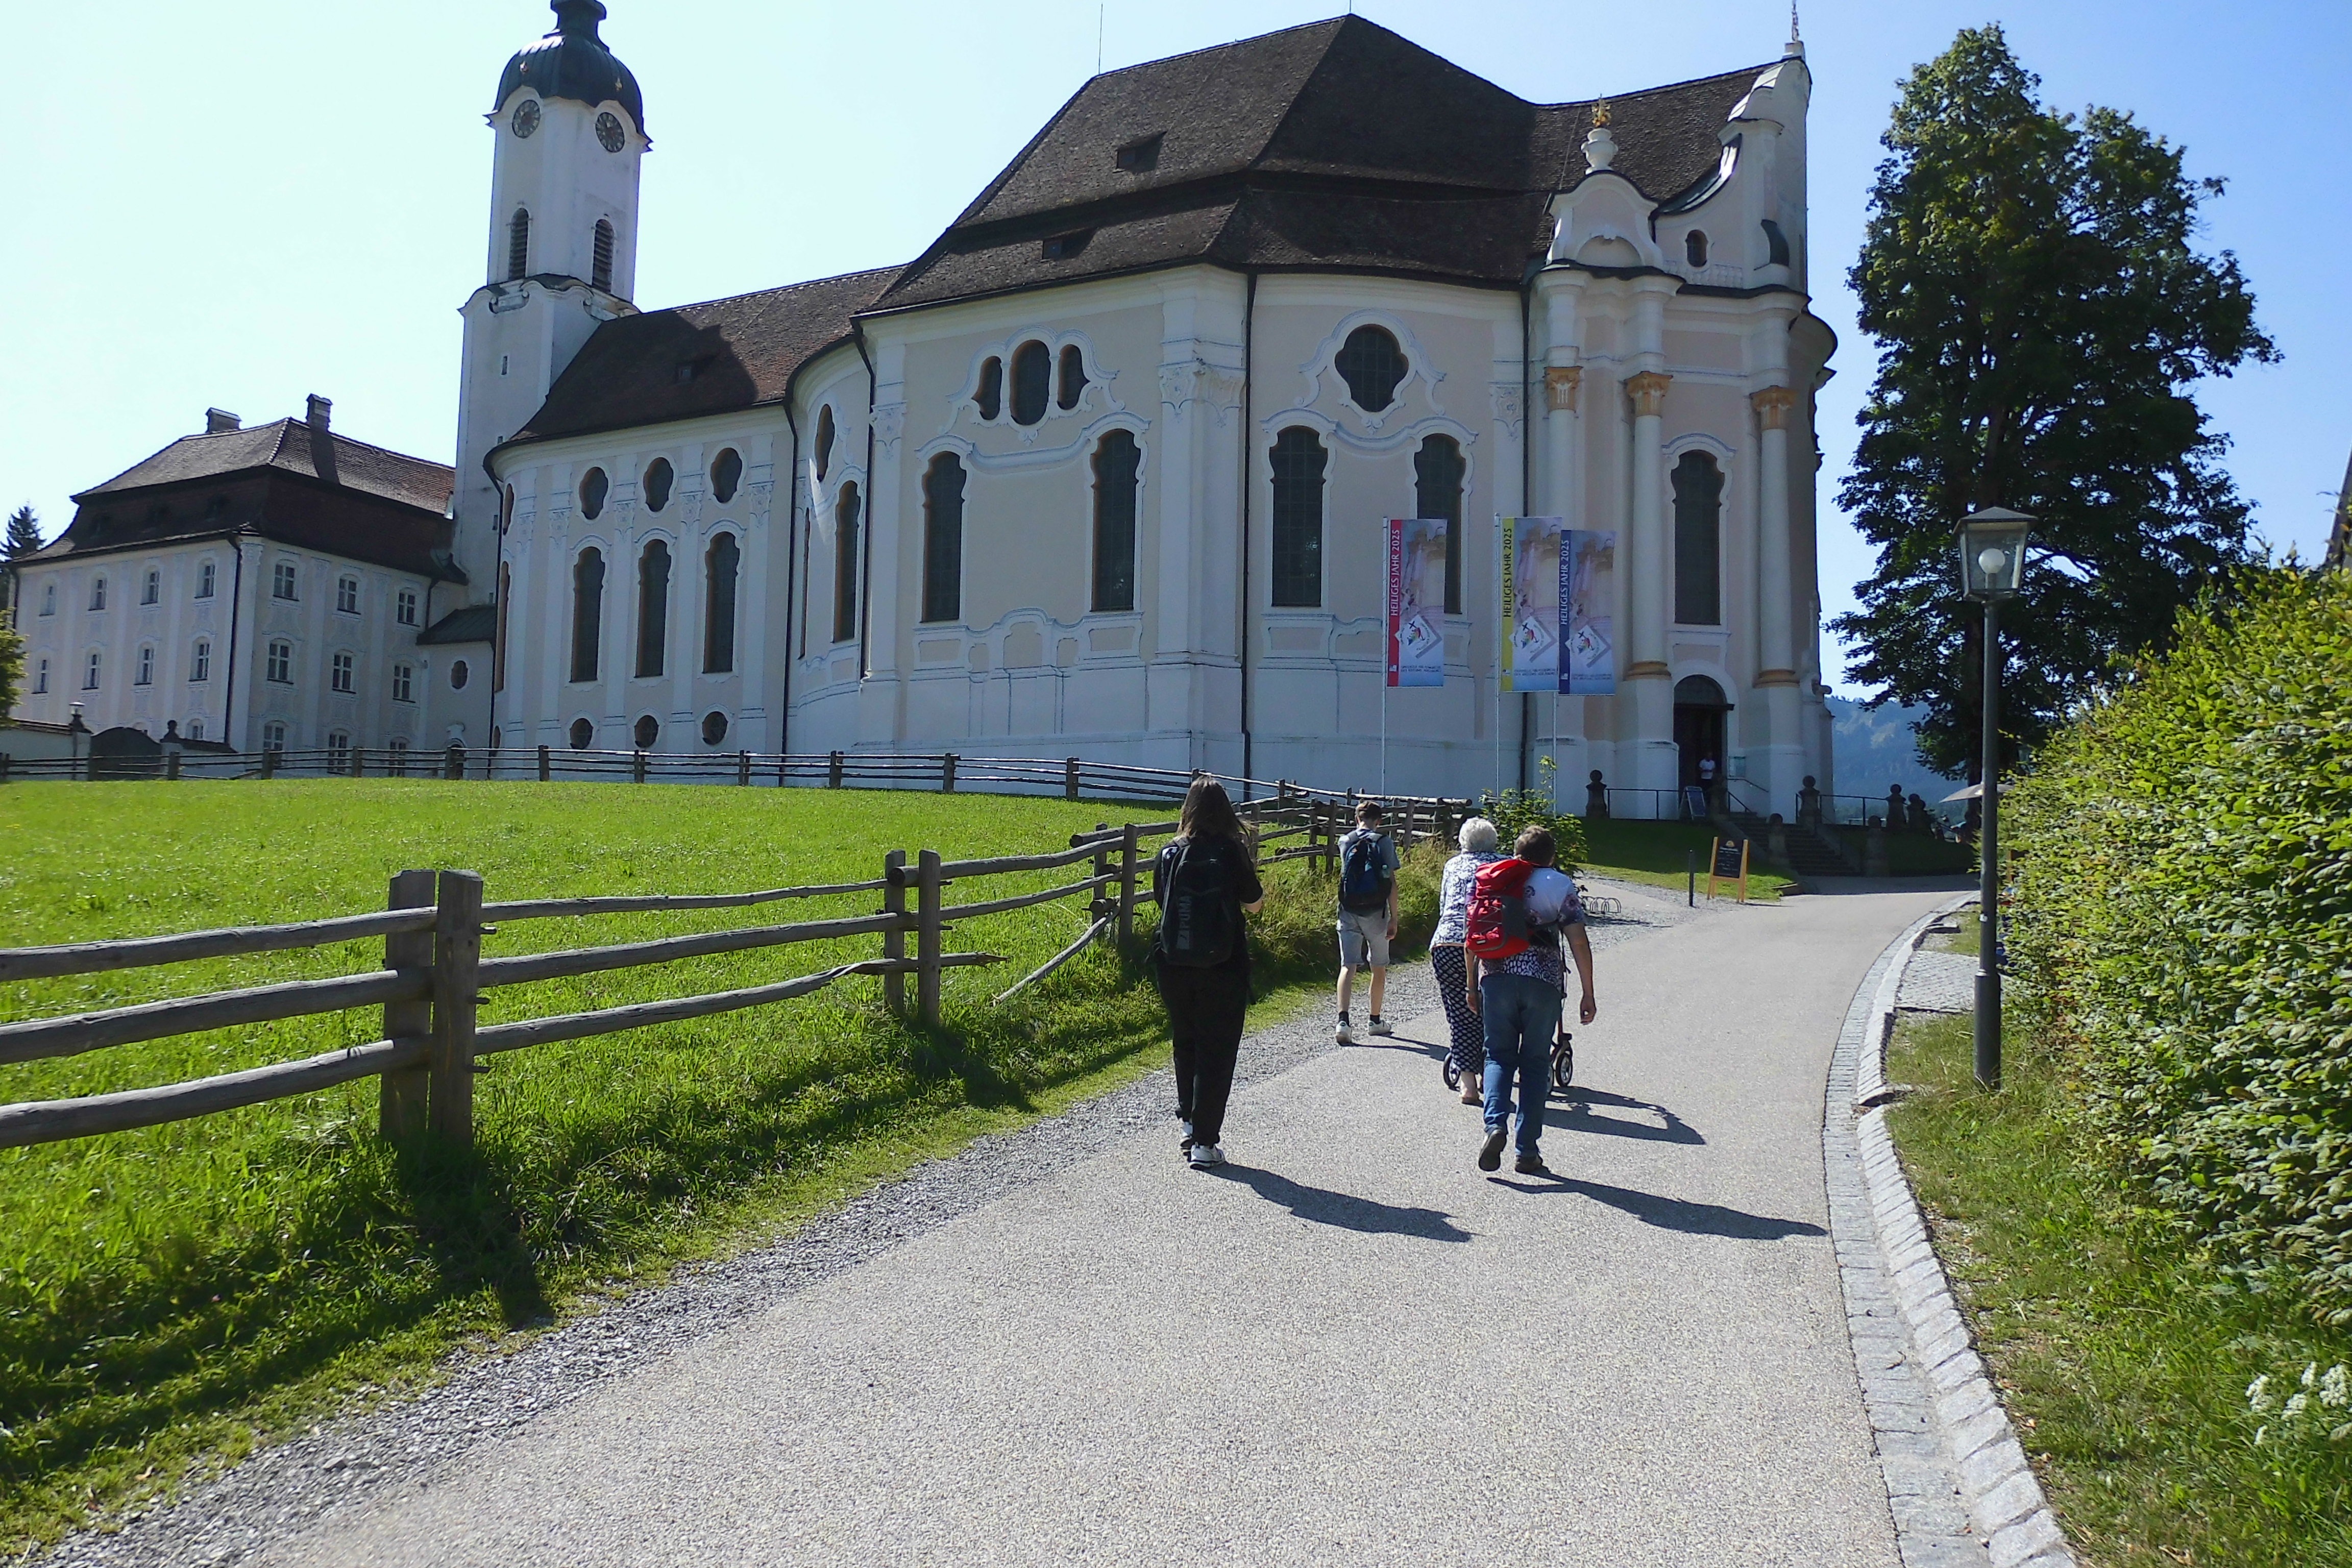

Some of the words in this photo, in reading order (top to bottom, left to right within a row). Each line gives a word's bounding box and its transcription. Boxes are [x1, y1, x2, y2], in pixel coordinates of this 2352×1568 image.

[1392, 530, 1400, 551] 2025
[1504, 528, 1512, 550] 2025
[1391, 554, 1400, 576] JAHR
[1504, 553, 1512, 575] JAHR
[1390, 578, 1399, 616] HEILIGES
[1503, 578, 1512, 618] HEILIGES
[1179, 895, 1191, 929] PUMA
